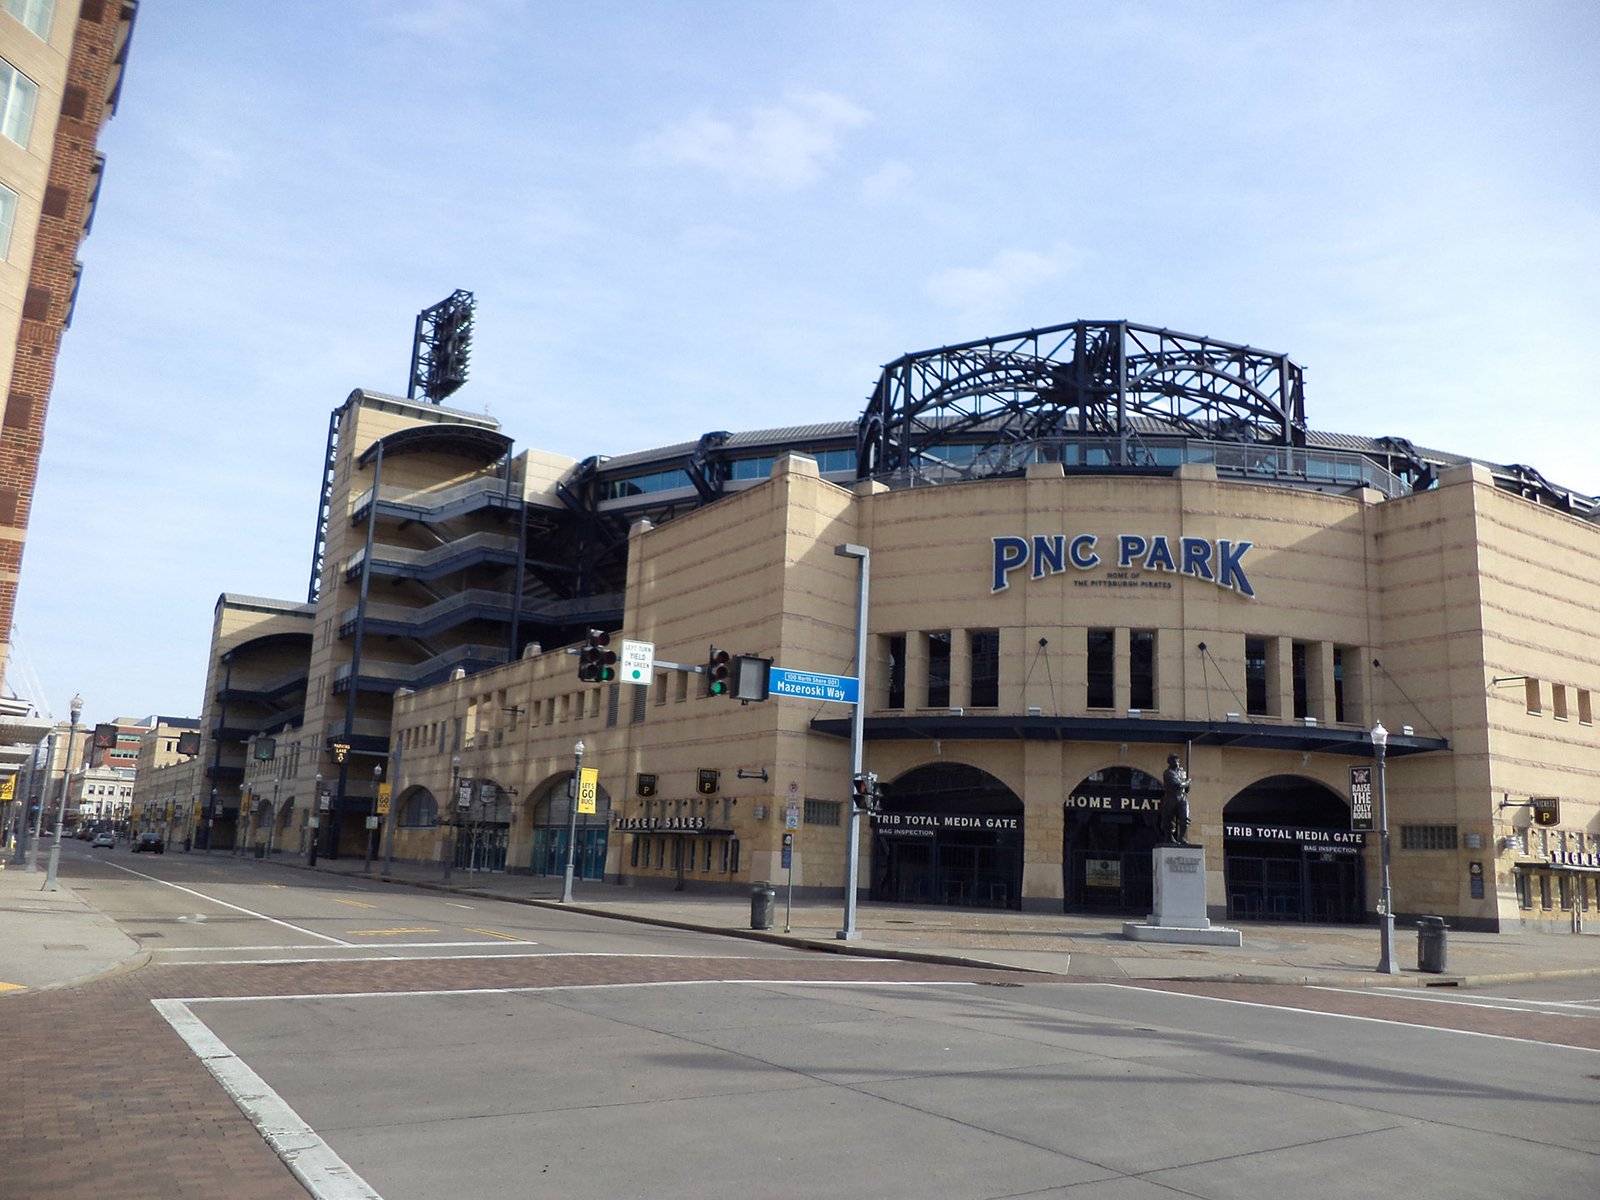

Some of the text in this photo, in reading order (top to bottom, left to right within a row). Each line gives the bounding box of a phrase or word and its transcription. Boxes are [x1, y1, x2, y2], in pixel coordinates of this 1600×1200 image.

[991, 534, 1255, 600] PNC PARK
[1091, 580, 1138, 588] PITTSBURGH
[1141, 581, 1172, 589] PIRATES
[812, 676, 827, 684] Shore
[777, 680, 845, 701] Mazeroski Way
[1351, 783, 1371, 792] RAISE
[581, 789, 594, 799] GO
[1352, 792, 1371, 804] THE
[1065, 796, 1161, 811] HOME PLAT
[1353, 804, 1371, 812] JOLLY
[616, 816, 704, 829] TICKET SALES
[875, 815, 1017, 829] TRIB TOTAL MEDIA GATE
[894, 828, 934, 837] INSPECTION
[1226, 826, 1363, 843] TRIB TOTAL MEDIA GATE
[1318, 845, 1358, 854] INSPECTION
[1553, 850, 1600, 867] TICKE
